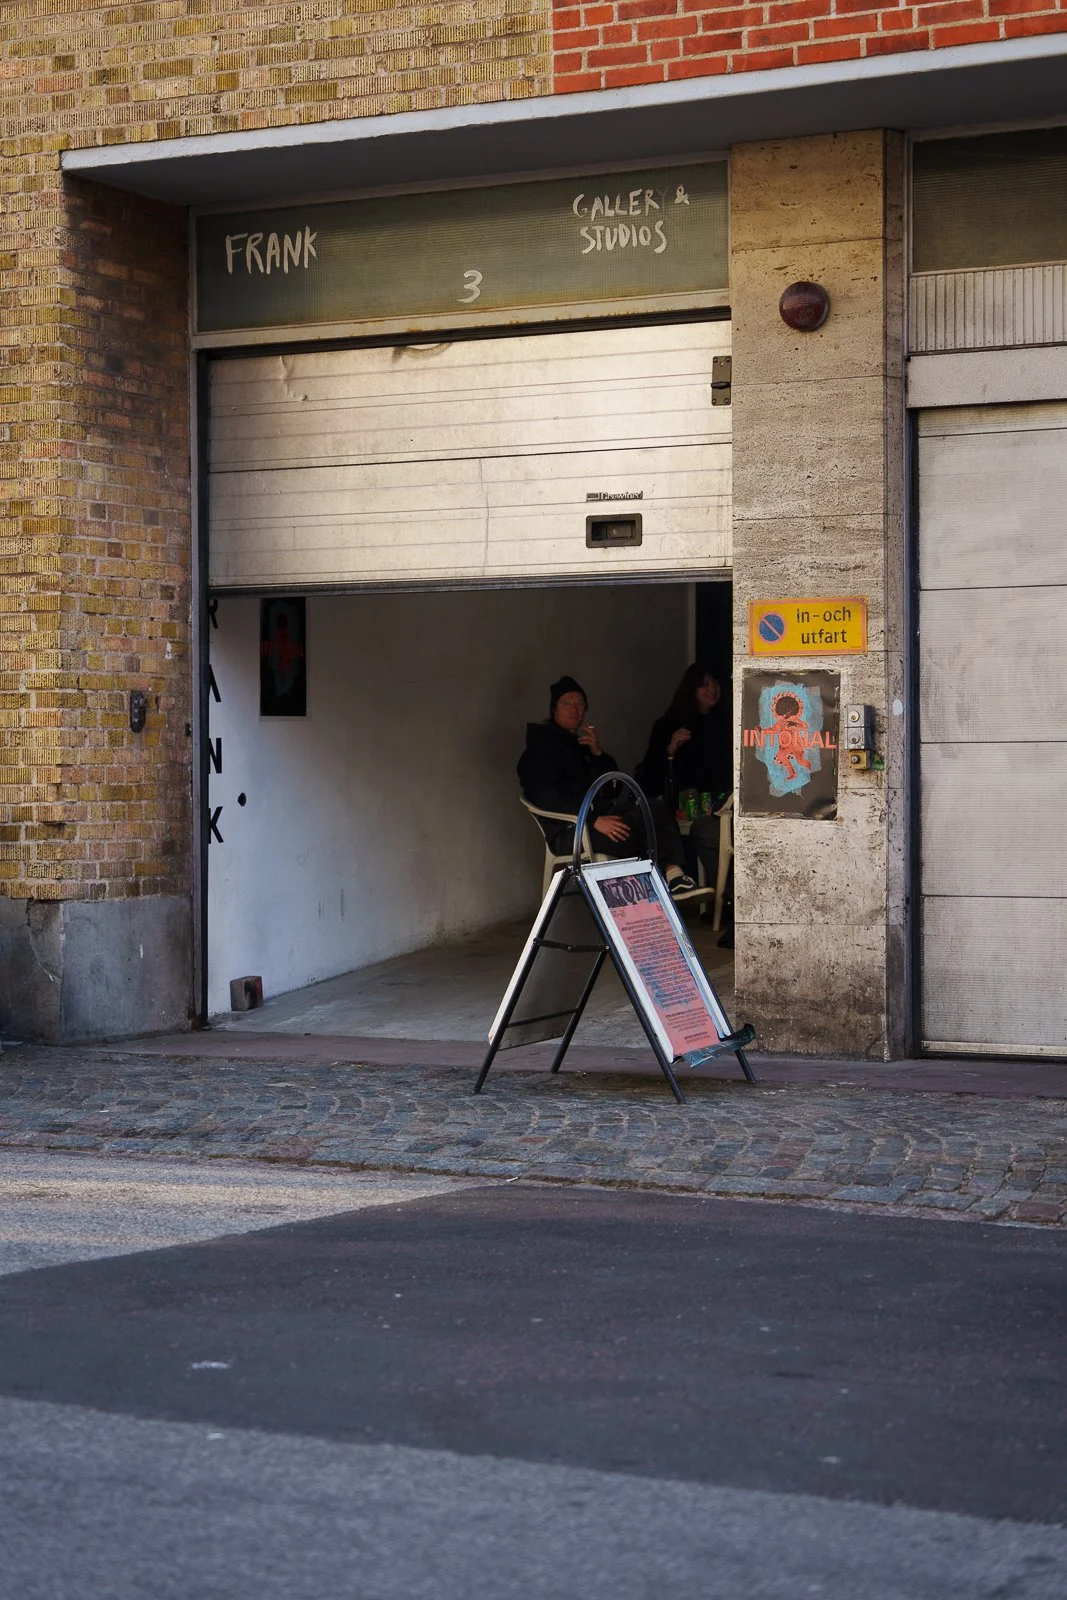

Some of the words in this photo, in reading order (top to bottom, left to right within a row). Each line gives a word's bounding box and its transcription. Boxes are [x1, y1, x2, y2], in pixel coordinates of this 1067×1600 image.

[674, 184, 691, 205] &
[225, 226, 318, 275] FRANK
[579, 220, 668, 255] STUDIOS
[457, 269, 483, 304] 3
[801, 628, 848, 645] utfart
[743, 729, 837, 749] INTONAL
